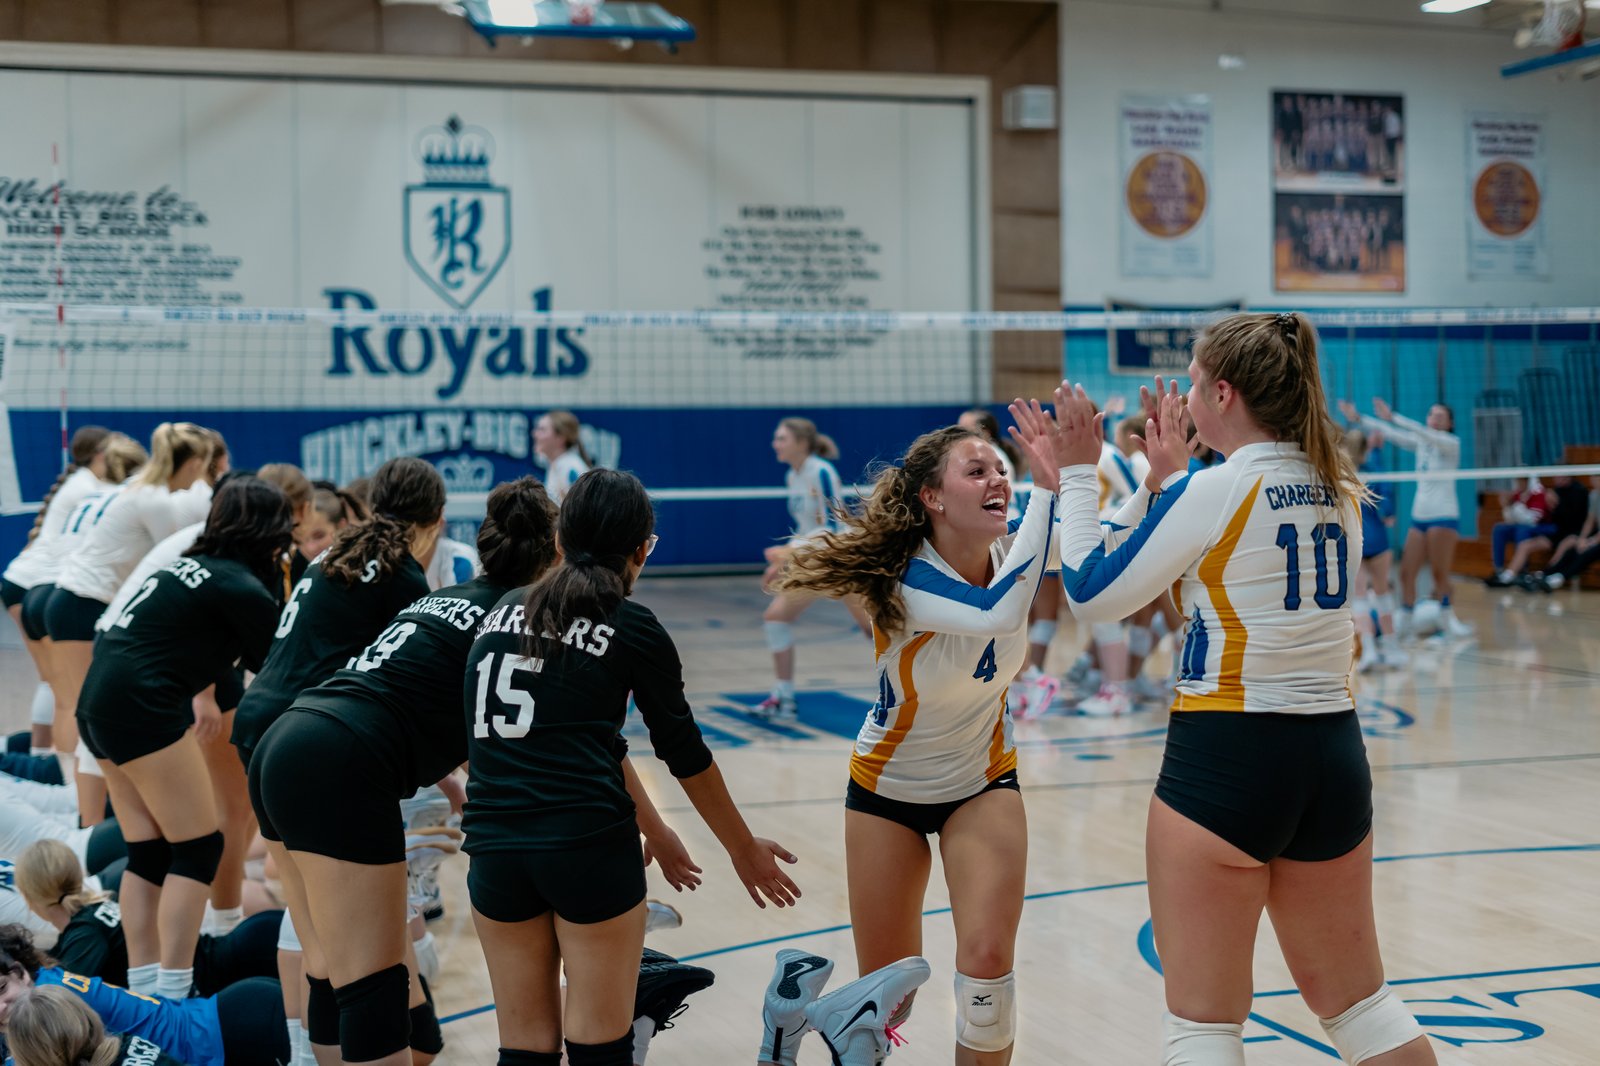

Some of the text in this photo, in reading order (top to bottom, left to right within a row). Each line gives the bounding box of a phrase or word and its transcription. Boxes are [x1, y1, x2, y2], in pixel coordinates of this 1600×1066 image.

[322, 286, 592, 400] Royals
[1264, 484, 1340, 511] CHARGER
[1275, 522, 1348, 611] 10
[275, 577, 313, 639] 6
[473, 652, 545, 739] 15
[972, 637, 998, 683] 4
